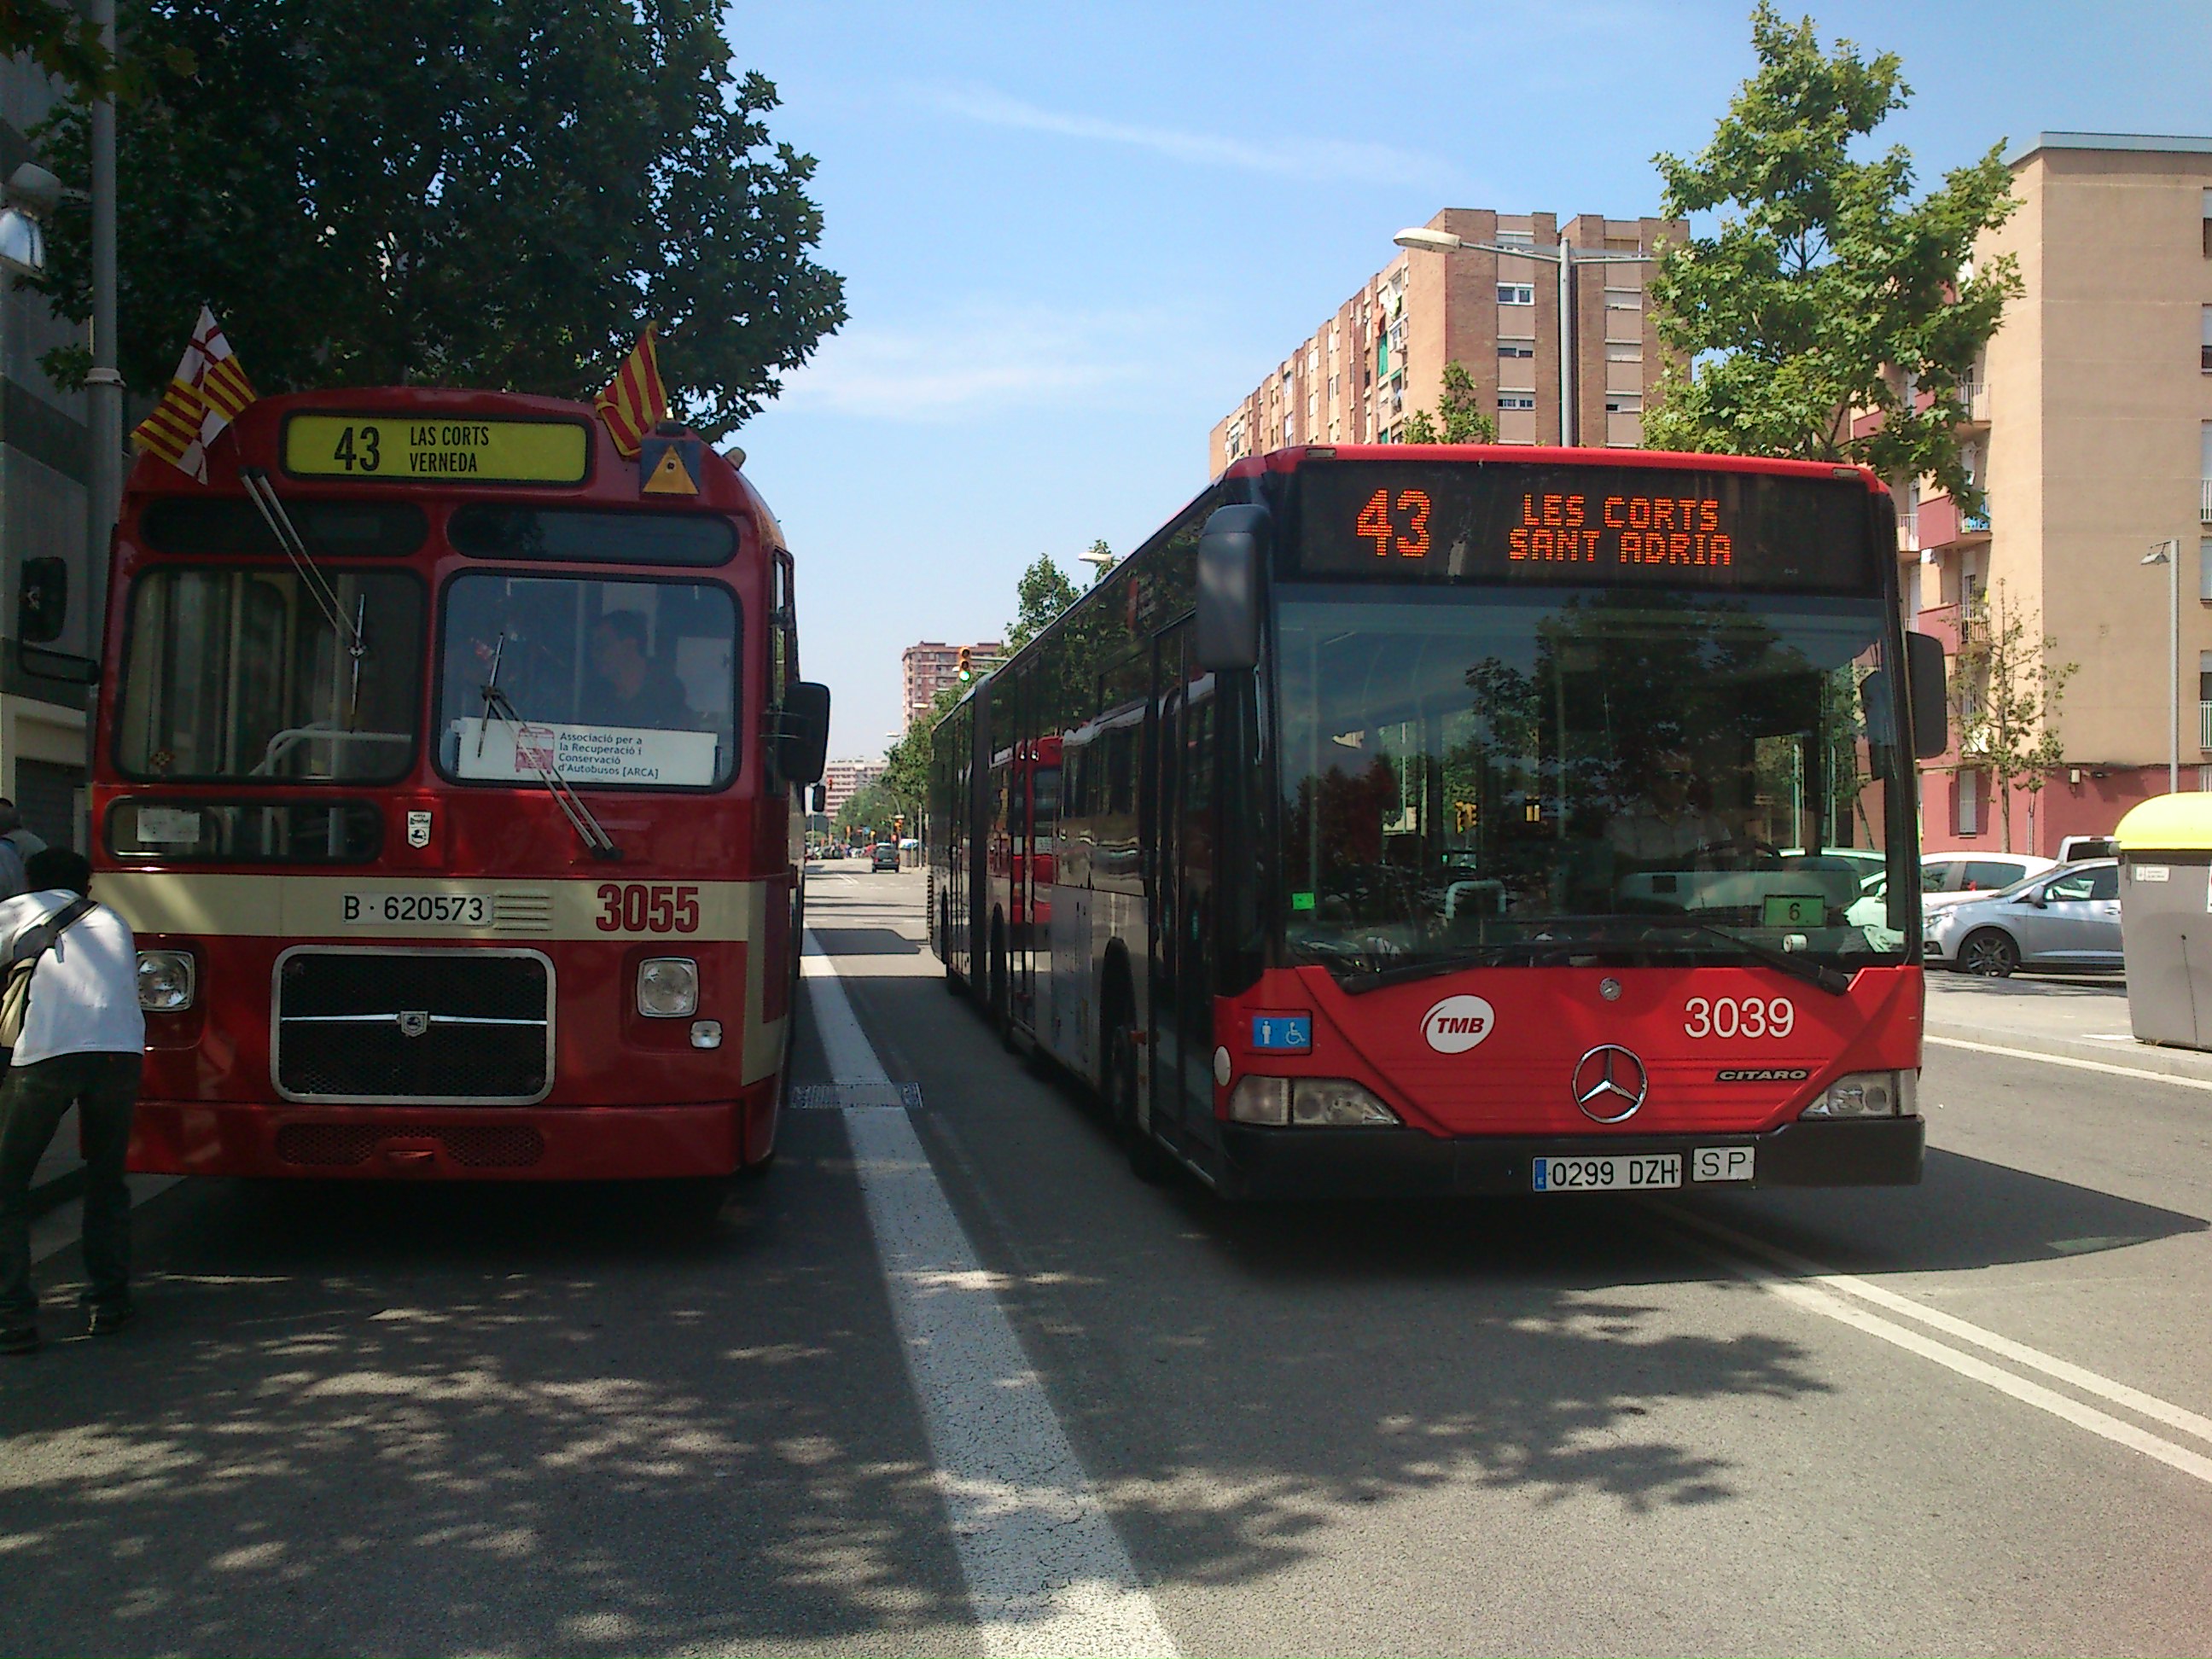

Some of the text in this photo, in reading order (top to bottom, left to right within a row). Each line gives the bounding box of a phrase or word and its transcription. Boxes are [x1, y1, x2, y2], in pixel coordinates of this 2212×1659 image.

[410, 426, 489, 446] LAS CORTS
[334, 427, 381, 471] 43
[410, 452, 478, 472] VERNEDA
[1522, 492, 1720, 532] LES CORTS
[1356, 488, 1431, 558] 43
[1509, 527, 1732, 566] SANT ADRIA
[560, 731, 613, 744] Associació
[616, 736, 632, 746] per
[558, 753, 621, 765] Conservació
[559, 742, 569, 751] la
[572, 743, 635, 756] Recuperació
[558, 764, 659, 780] d'Autobusos [ARCA]
[597, 883, 700, 933] 3055
[1789, 902, 1801, 922] 6
[1437, 1017, 1485, 1034] TMB
[1684, 997, 1796, 1039] 3039
[1718, 1069, 1807, 1081] CITARO
[1552, 1161, 1615, 1186] 0299
[1629, 1160, 1676, 1185] DZH
